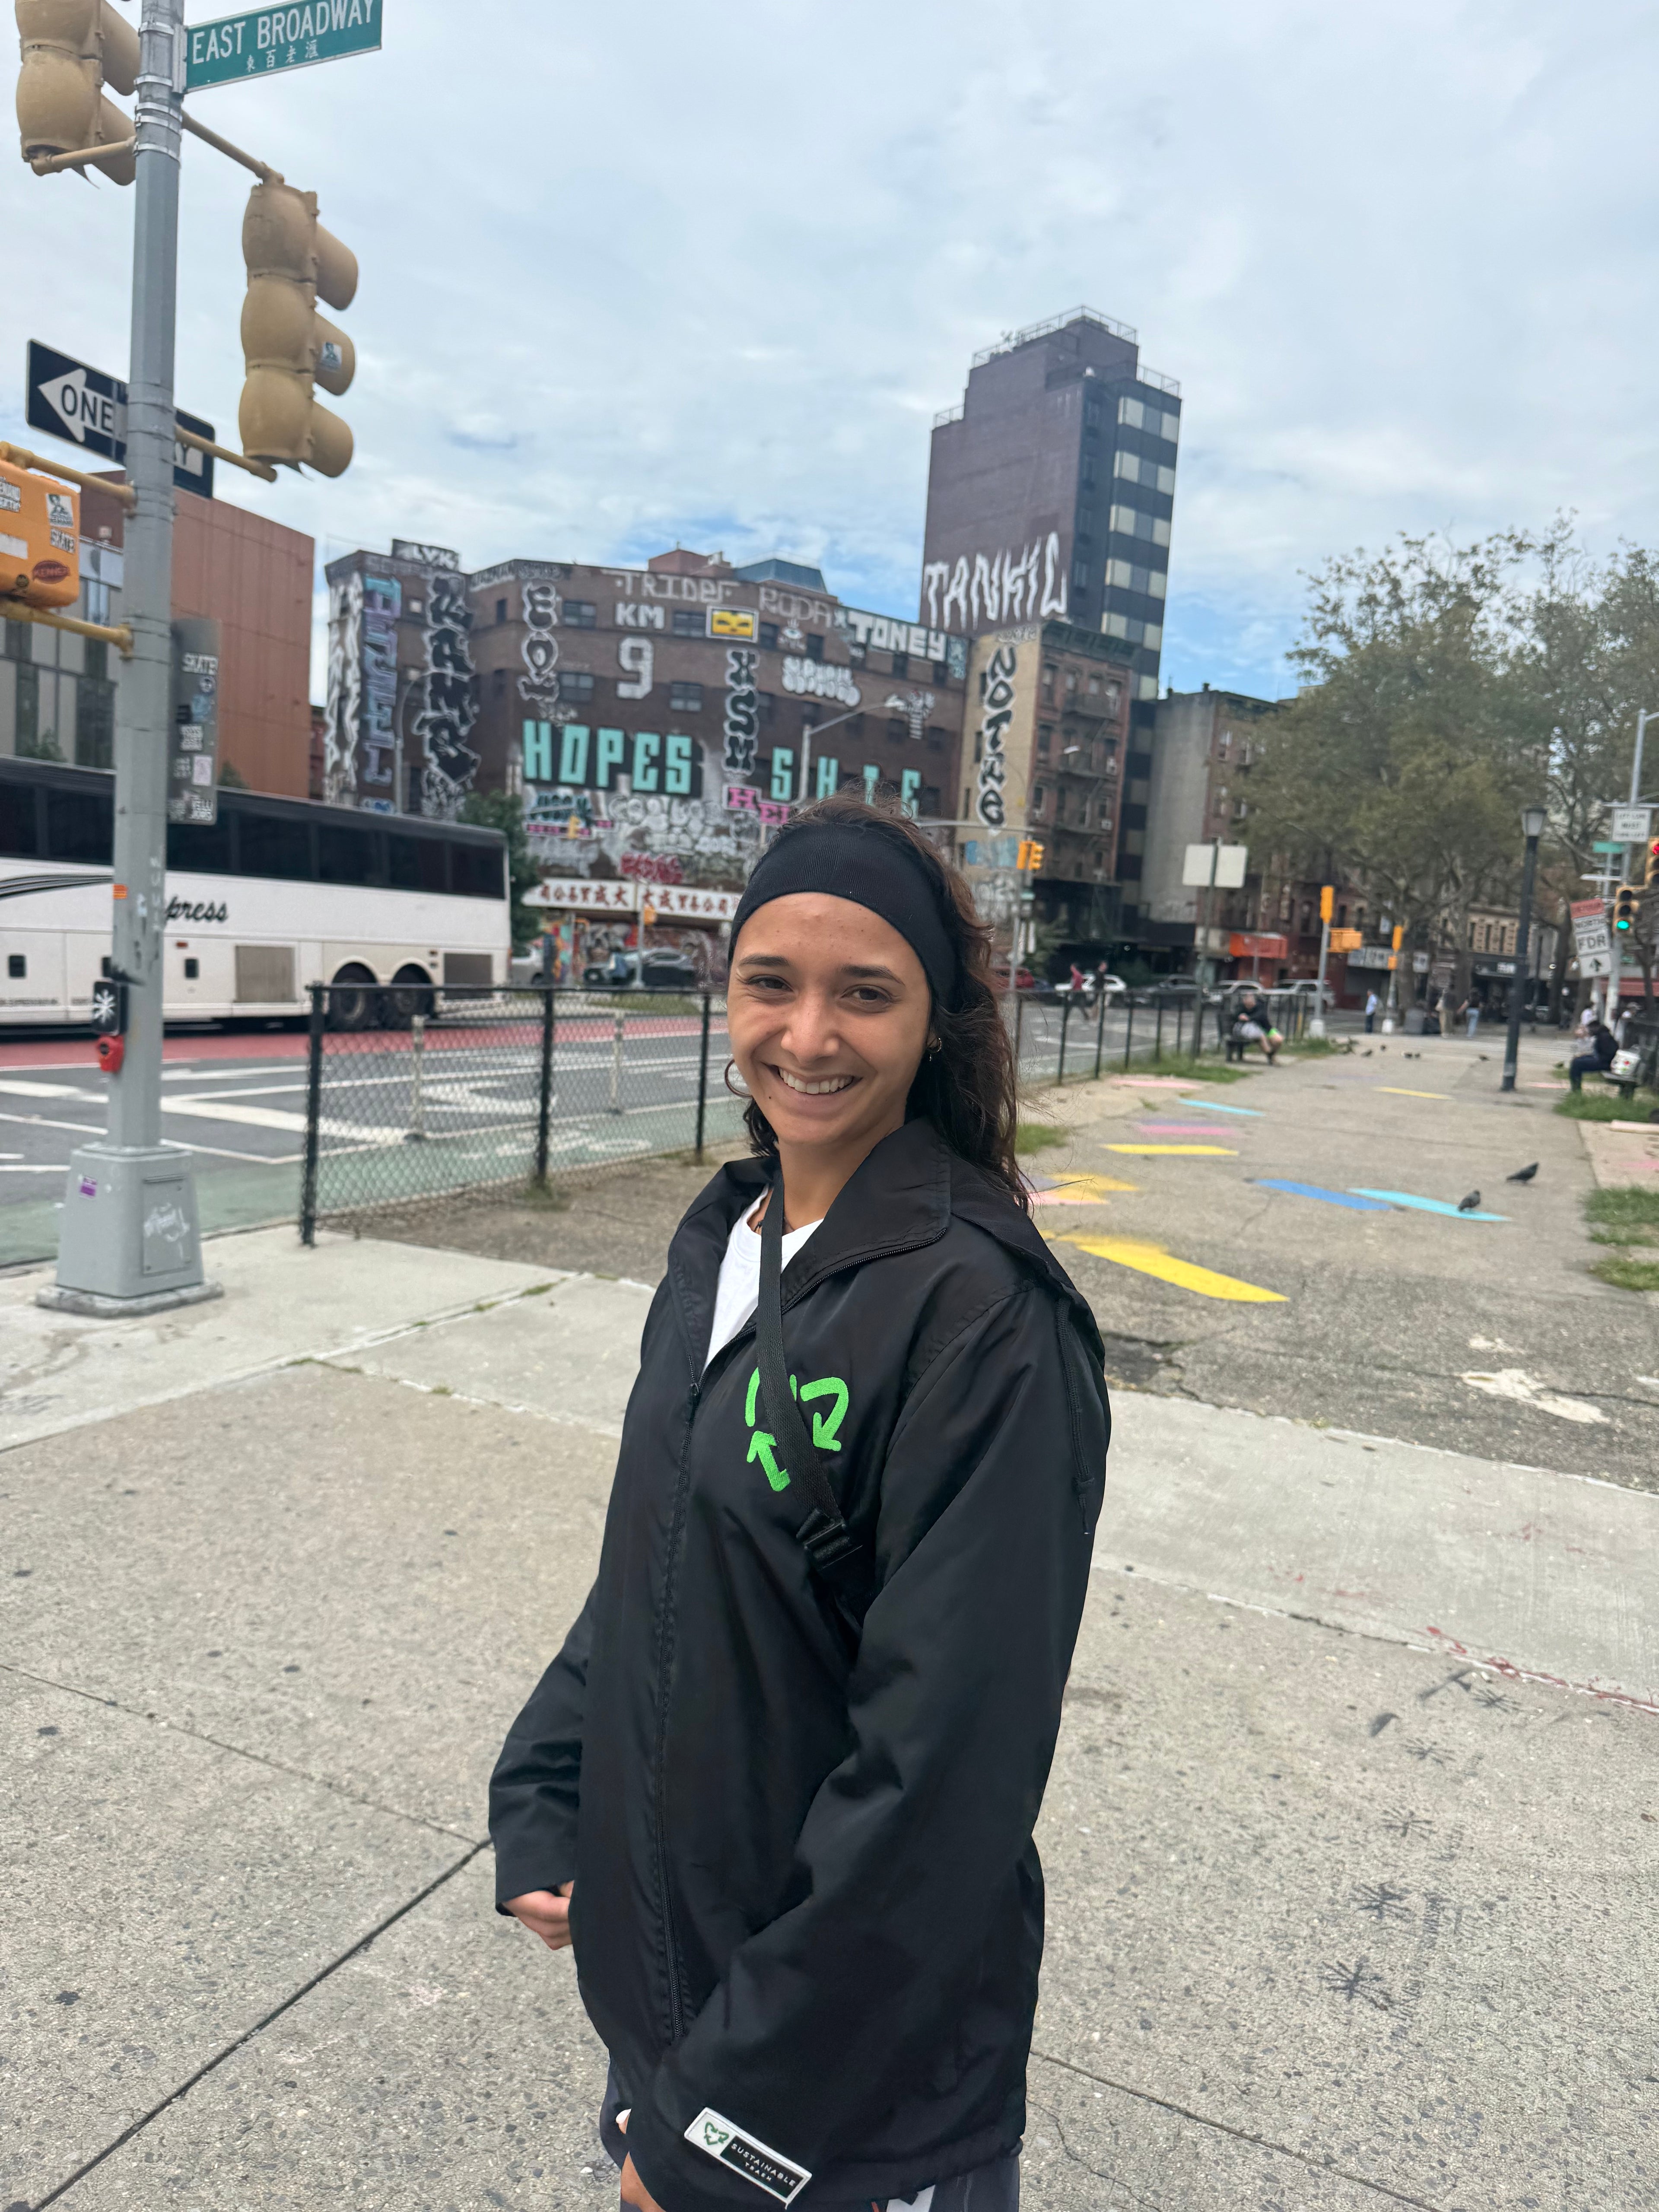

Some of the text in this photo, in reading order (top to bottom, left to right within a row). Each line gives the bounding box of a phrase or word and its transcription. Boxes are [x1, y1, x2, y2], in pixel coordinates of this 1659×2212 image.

[193, 0, 374, 64] EAST BROADWAY
[61, 384, 114, 432] ONE
[615, 602, 665, 629] KM
[848, 610, 946, 662] TONEY
[617, 636, 654, 699] 9
[523, 718, 691, 795] HOPES
[1578, 932, 1606, 950] FDR
[731, 2143, 796, 2187] SUSTAINABLE
[745, 2162, 772, 2182] TRASH
